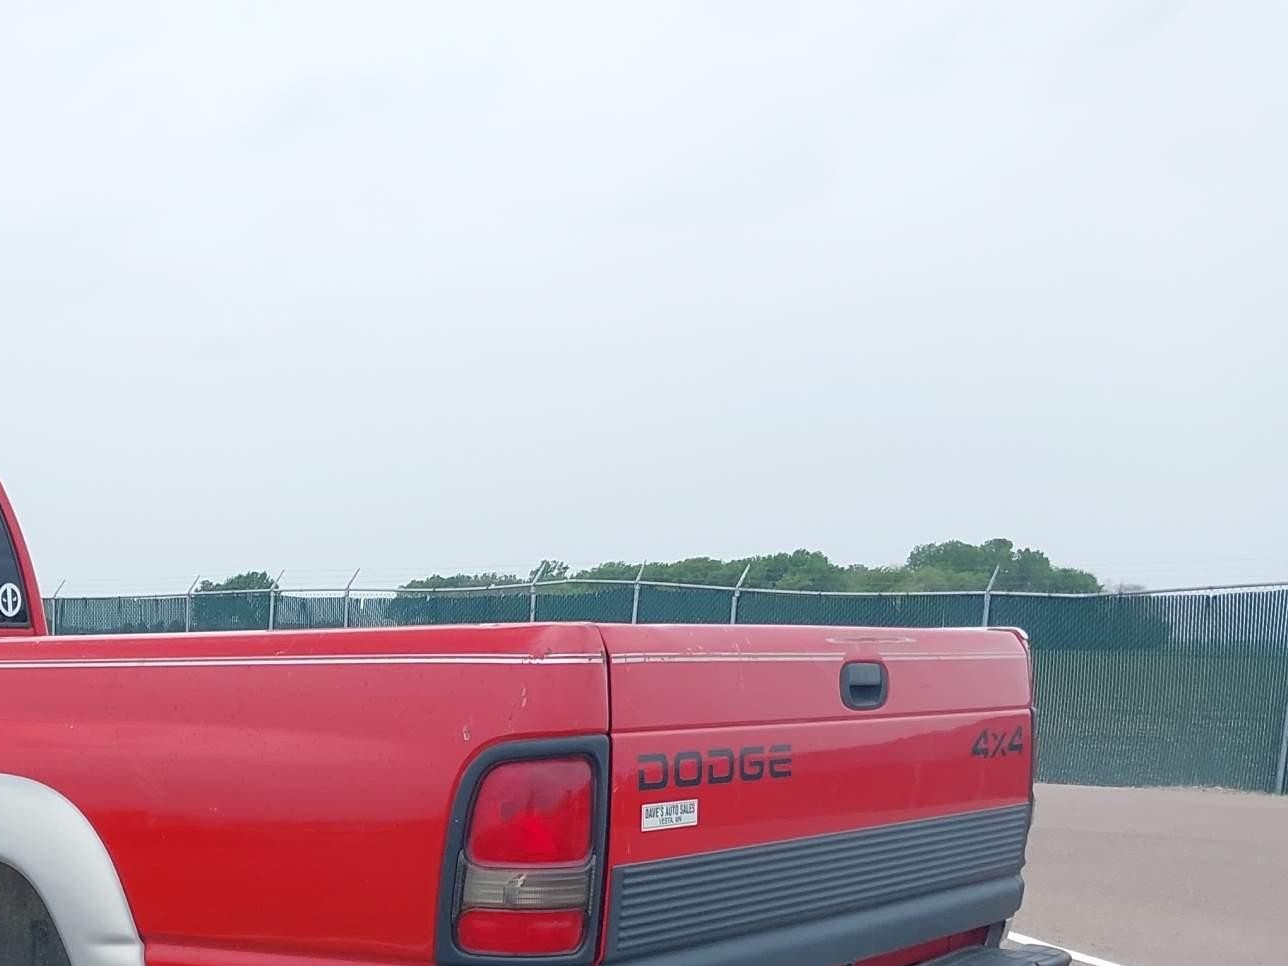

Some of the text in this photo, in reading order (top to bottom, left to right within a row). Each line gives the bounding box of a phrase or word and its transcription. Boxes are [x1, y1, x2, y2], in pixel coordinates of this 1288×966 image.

[637, 743, 793, 792] DODGE
[644, 802, 696, 819] DAVE'S AUTO SALES
